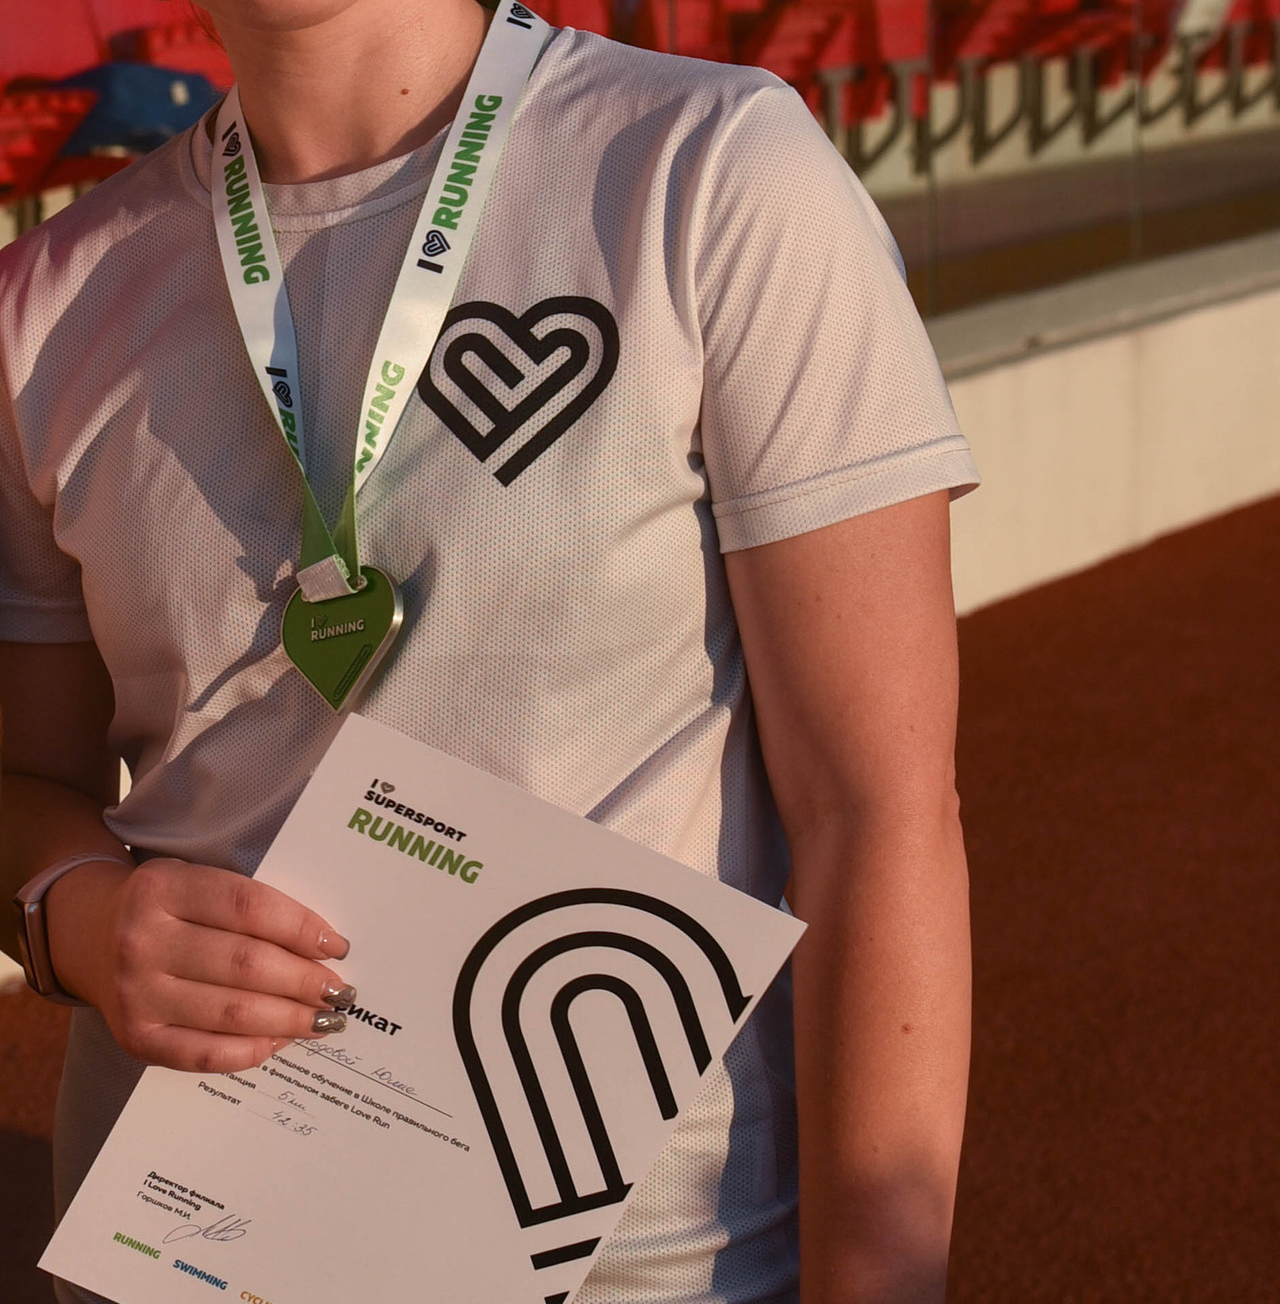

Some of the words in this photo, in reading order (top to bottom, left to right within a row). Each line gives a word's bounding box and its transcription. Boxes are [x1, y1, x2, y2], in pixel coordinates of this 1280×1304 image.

[431, 94, 503, 231] RUNNING
[224, 155, 270, 285] RUNNING
[310, 619, 365, 642] RUNNING
[363, 790, 467, 842] SUPERSPORT
[347, 807, 484, 884] RUNNING
[198, 1081, 242, 1106] Результат
[269, 1067, 319, 1096] финальном
[320, 1092, 350, 1111] забеге
[350, 1104, 372, 1121] Love
[372, 1114, 391, 1130] Run
[311, 1071, 352, 1096] обучение
[361, 1094, 392, 1114] Школе
[392, 1110, 450, 1143] правильного
[450, 1135, 470, 1152] бега
[136, 1190, 173, 1212] Горшков
[147, 1171, 189, 1194] Директор
[189, 1189, 225, 1210] филиала
[148, 1181, 167, 1195] Love
[168, 1190, 201, 1211] Running
[113, 1232, 161, 1259] RUNNING
[173, 1259, 228, 1290] SWIMMING
